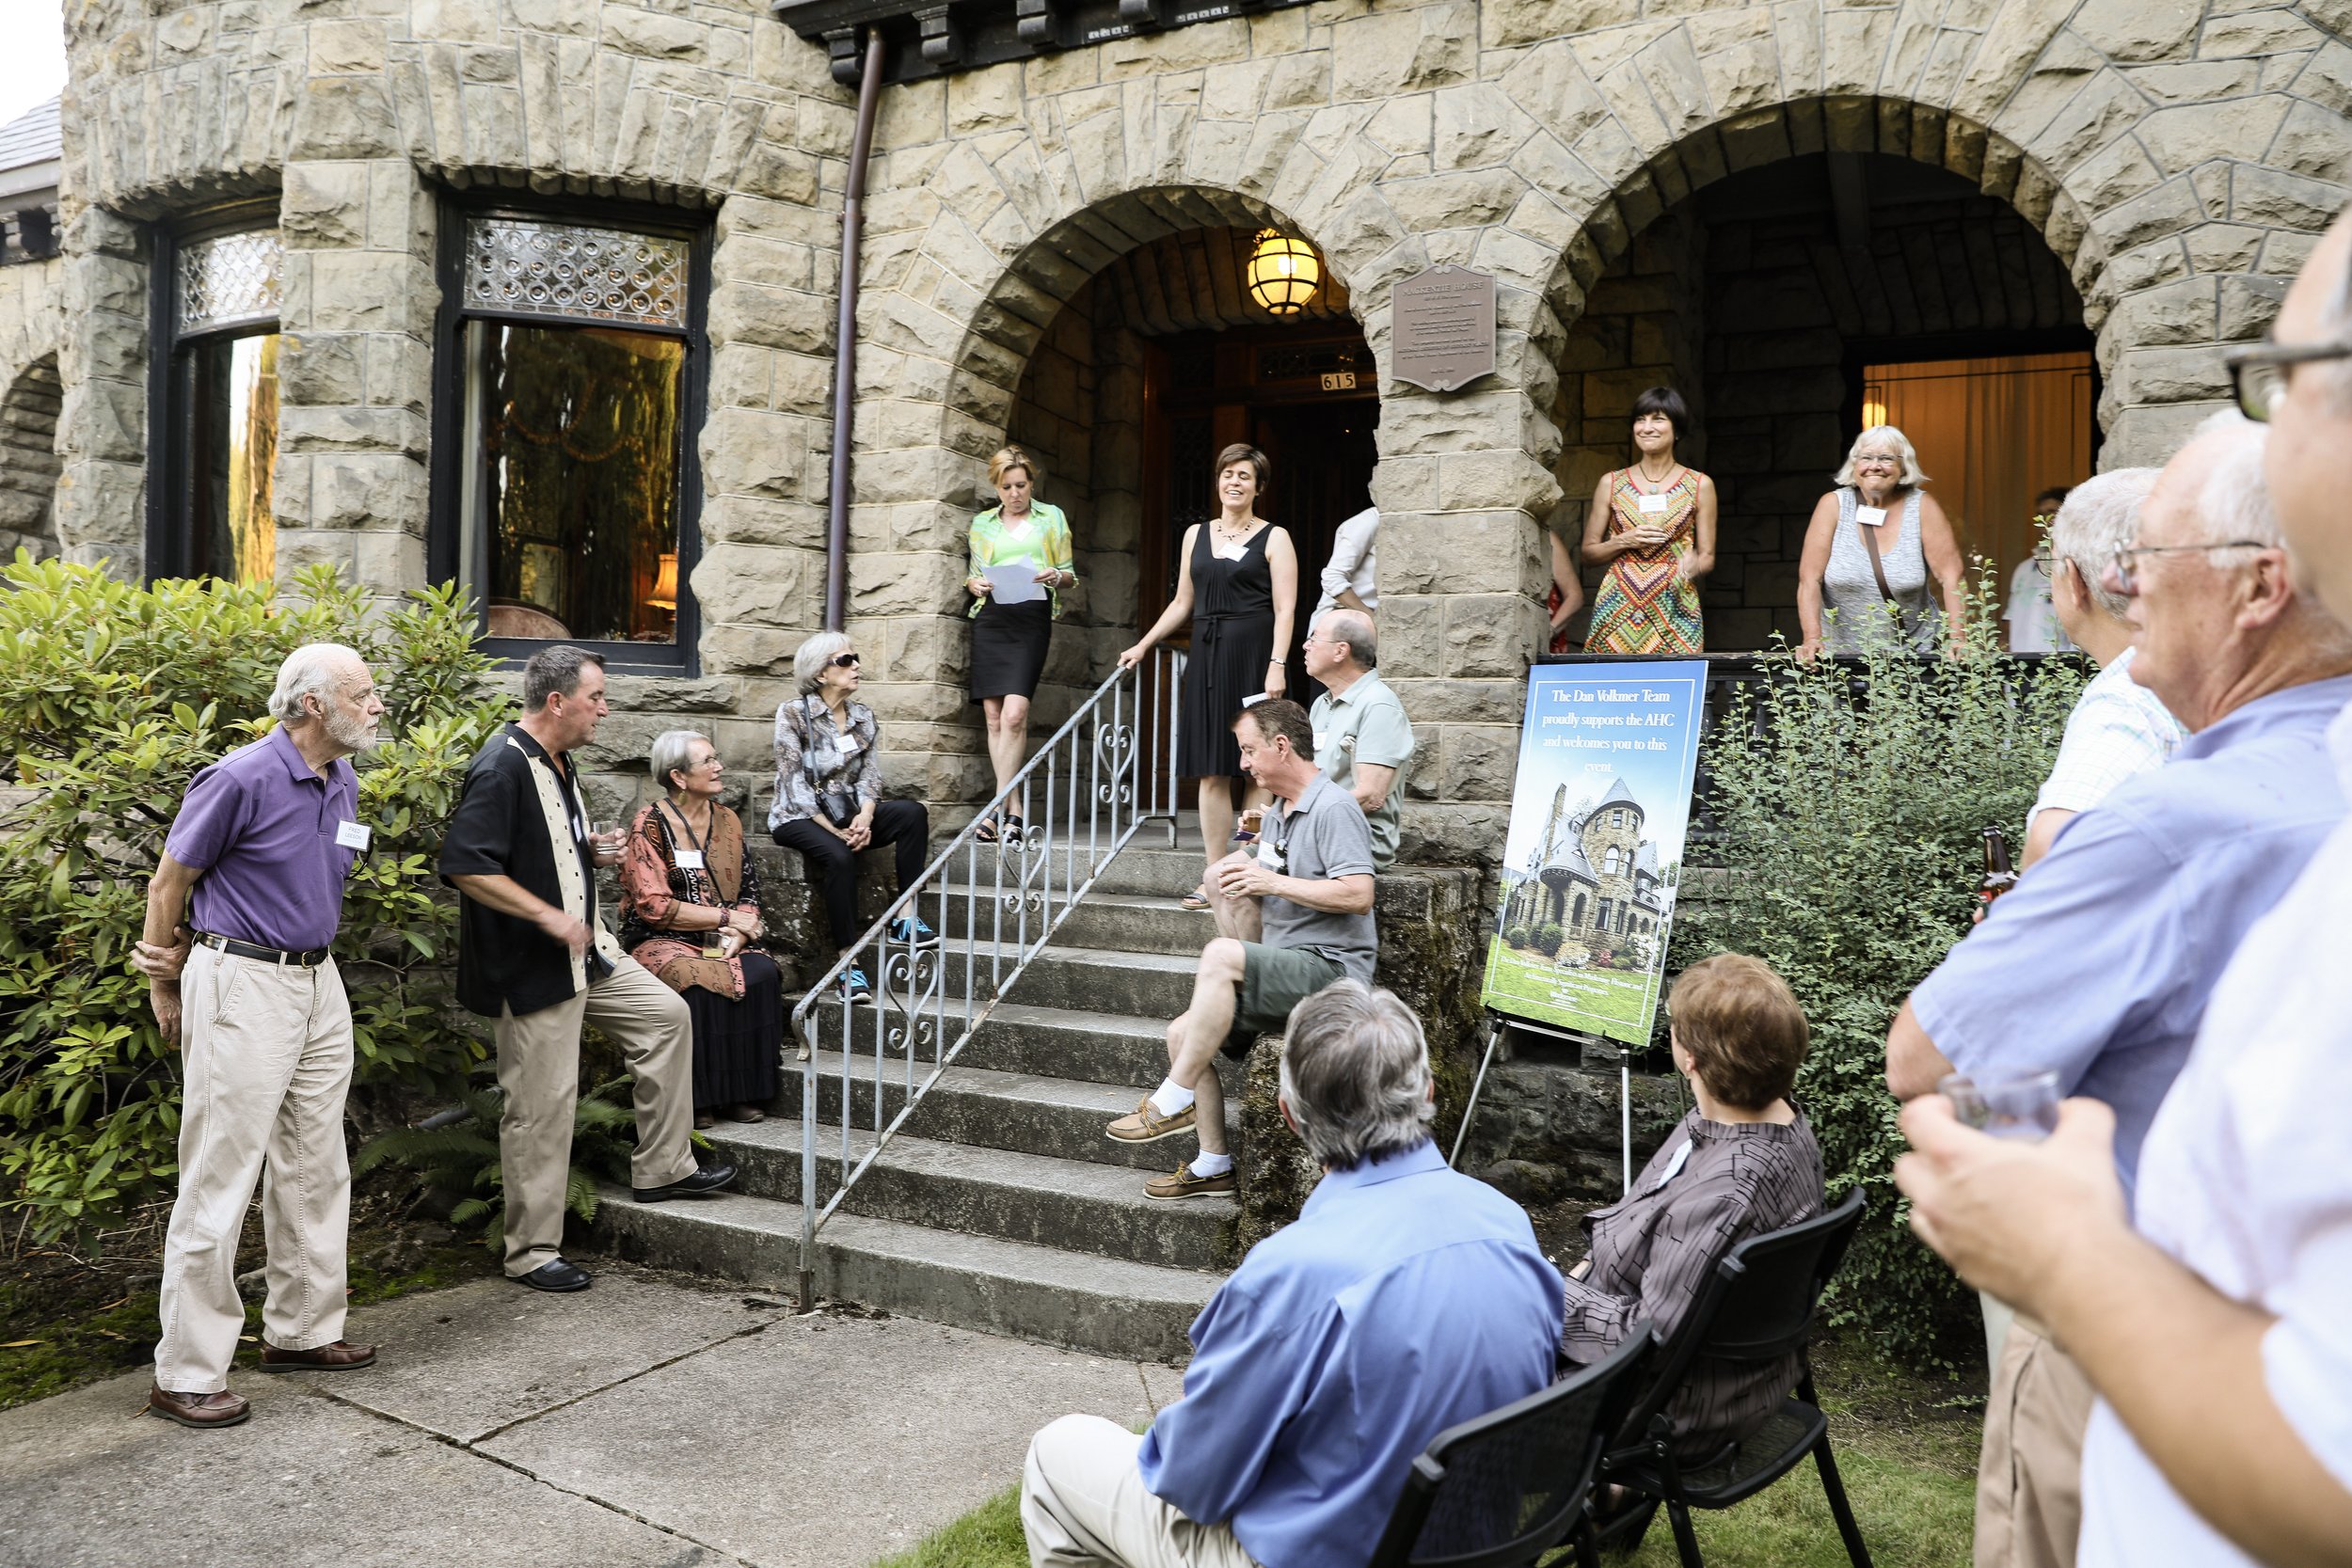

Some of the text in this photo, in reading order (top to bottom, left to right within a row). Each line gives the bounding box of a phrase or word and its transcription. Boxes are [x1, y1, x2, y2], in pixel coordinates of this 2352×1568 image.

[1454, 281, 1484, 291] HOUSE
[1324, 374, 1354, 388] 615
[1551, 689, 1671, 703] The Dan Volkmer Team
[1542, 712, 1676, 730] proudly supports the AHC
[1543, 735, 1668, 753] and welcomes you to this
